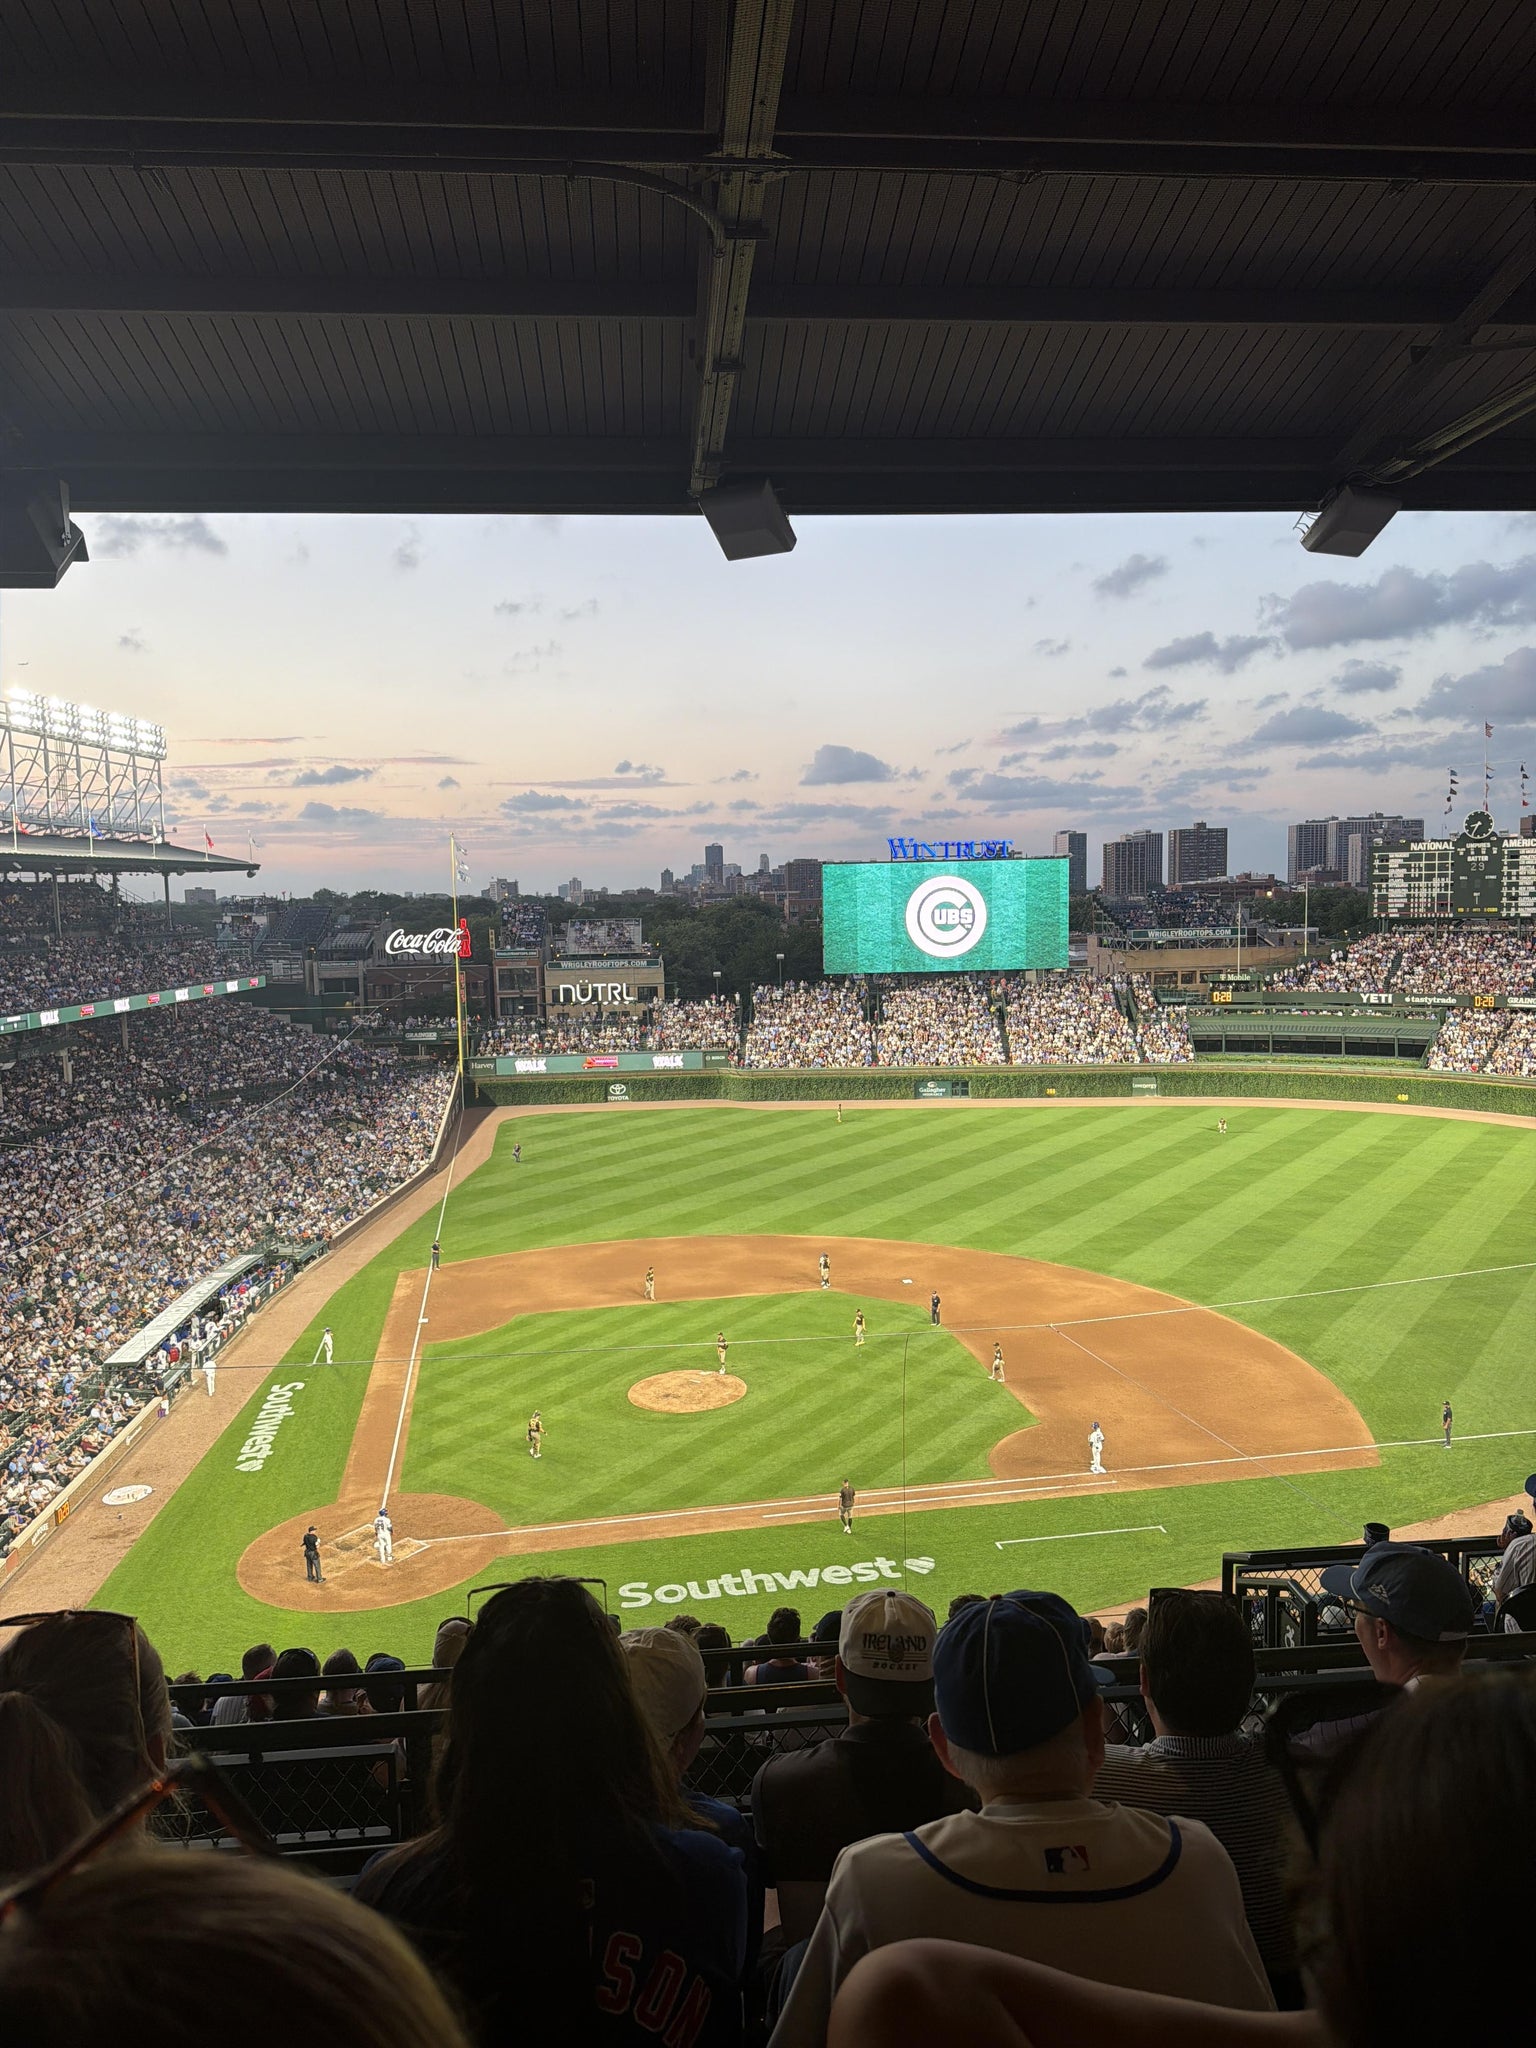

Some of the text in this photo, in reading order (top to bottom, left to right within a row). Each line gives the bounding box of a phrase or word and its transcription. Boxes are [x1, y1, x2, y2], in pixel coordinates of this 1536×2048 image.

[886, 837, 1014, 860] WINTRUST
[1410, 841, 1455, 851] NATIONAL
[1502, 838, 1536, 848] AMERIC
[1470, 862, 1485, 872] 29
[919, 889, 973, 943] CUBS
[385, 927, 464, 955] Coca-Cola
[560, 960, 648, 969] WRIGLEYROOFTOPS.COM
[559, 979, 635, 1003] NÜTRL
[1213, 991, 1232, 1002] 0:28
[1359, 993, 1393, 1004] YETI
[1411, 995, 1457, 1005] tastytrade
[1474, 996, 1495, 1007] 0:28
[471, 1062, 495, 1070] Harvey
[237, 1382, 305, 1461] Southwest
[618, 1556, 902, 1609] Southwest
[861, 1632, 927, 1654] IRELAND
